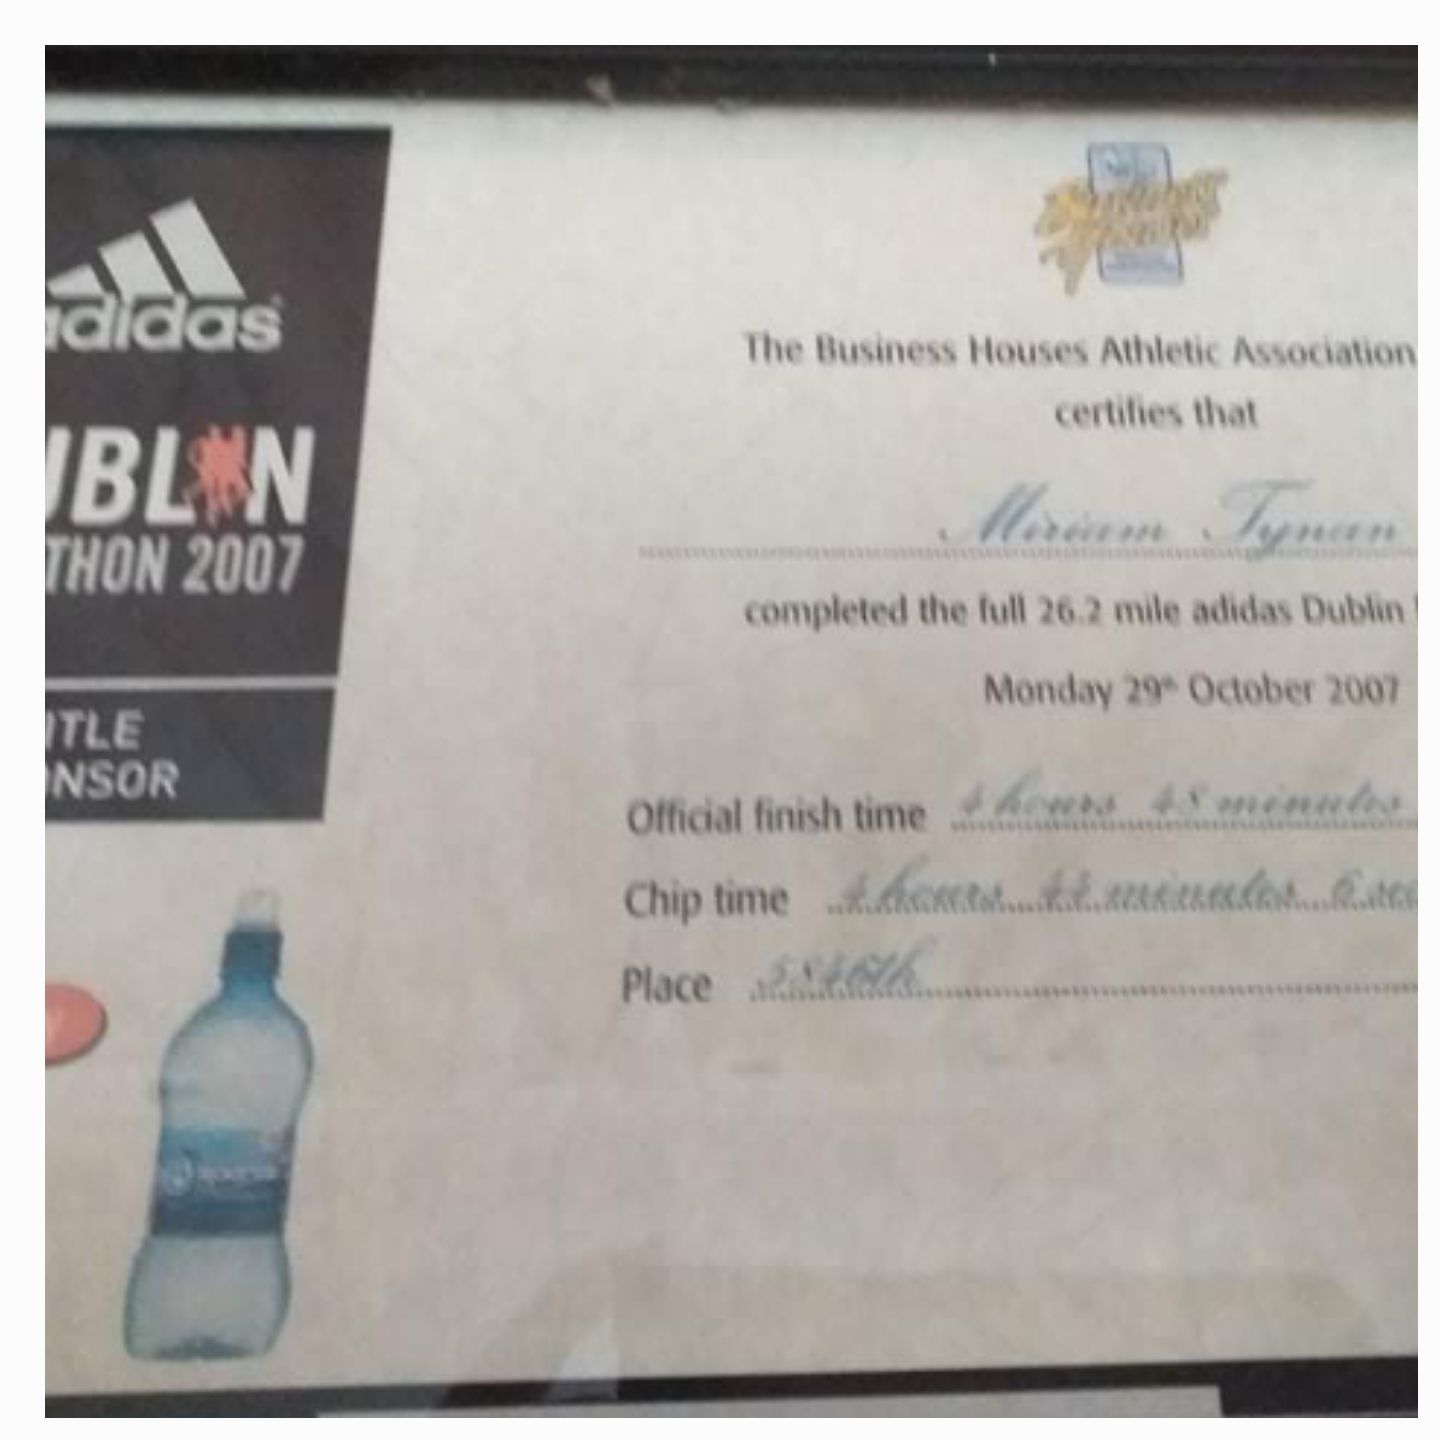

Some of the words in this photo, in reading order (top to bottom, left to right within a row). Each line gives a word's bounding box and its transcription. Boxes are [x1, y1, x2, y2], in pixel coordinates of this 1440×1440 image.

[742, 329, 803, 366] The
[814, 331, 957, 366] Business
[967, 332, 1088, 367] Houses
[1101, 333, 1219, 367] Athletic
[1231, 334, 1418, 369] Association
[1055, 395, 1183, 428] certifies
[1193, 396, 1259, 428] that
[181, 532, 305, 592] 2007
[743, 592, 907, 632] completed
[918, 592, 967, 625] the
[978, 592, 1025, 626] full
[1036, 594, 1102, 627] 26.2
[1114, 593, 1181, 625] mile
[1191, 592, 1293, 625] adidas
[1302, 592, 1405, 626] Dublin
[983, 672, 1113, 713] Monday
[1188, 672, 1316, 707] October
[1324, 672, 1400, 706] 2007
[626, 794, 742, 837] Official
[754, 792, 843, 833] finish
[853, 792, 928, 832] time
[624, 876, 703, 927] Chip
[713, 876, 790, 918] time
[621, 963, 714, 1004] Place
